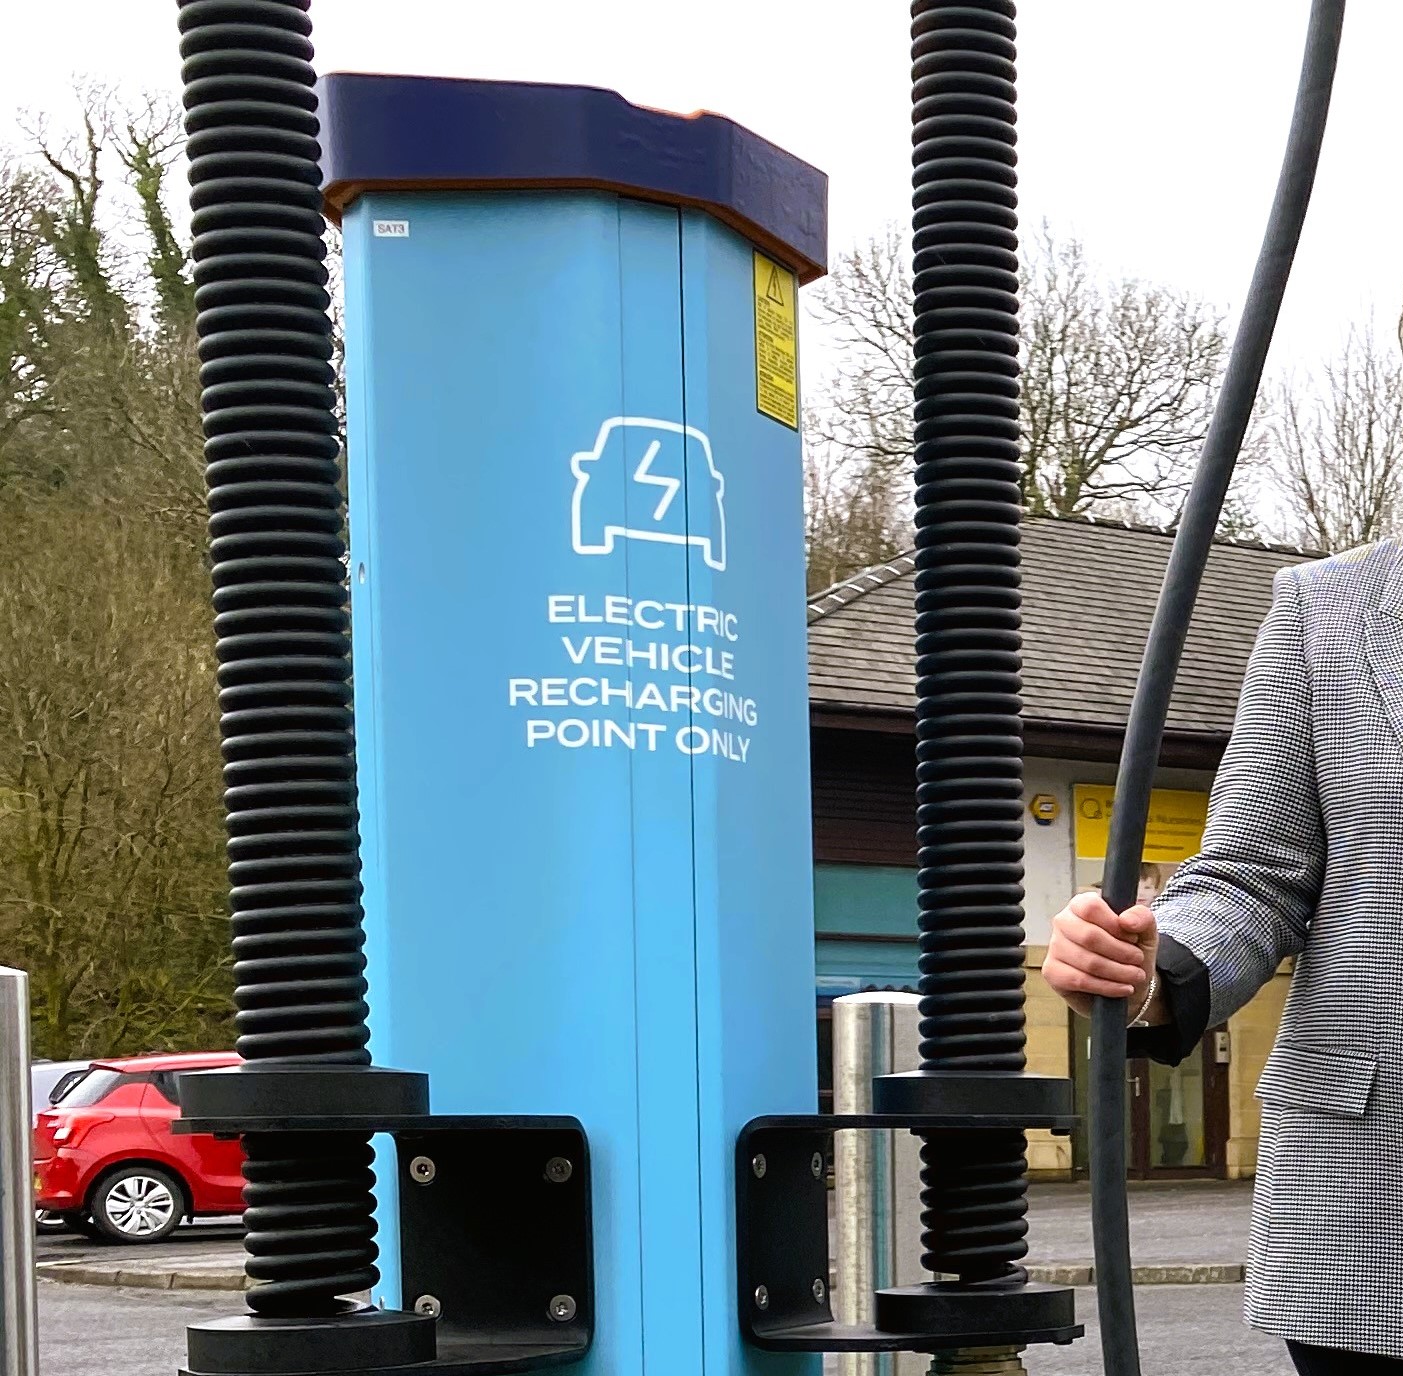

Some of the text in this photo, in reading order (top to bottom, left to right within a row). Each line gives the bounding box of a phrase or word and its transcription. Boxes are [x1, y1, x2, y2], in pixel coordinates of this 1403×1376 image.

[547, 595, 739, 641] ELECTRIC
[561, 636, 736, 680] VEHICLE
[508, 677, 759, 726] RECHARGING
[526, 718, 752, 764] POINT ONLY
